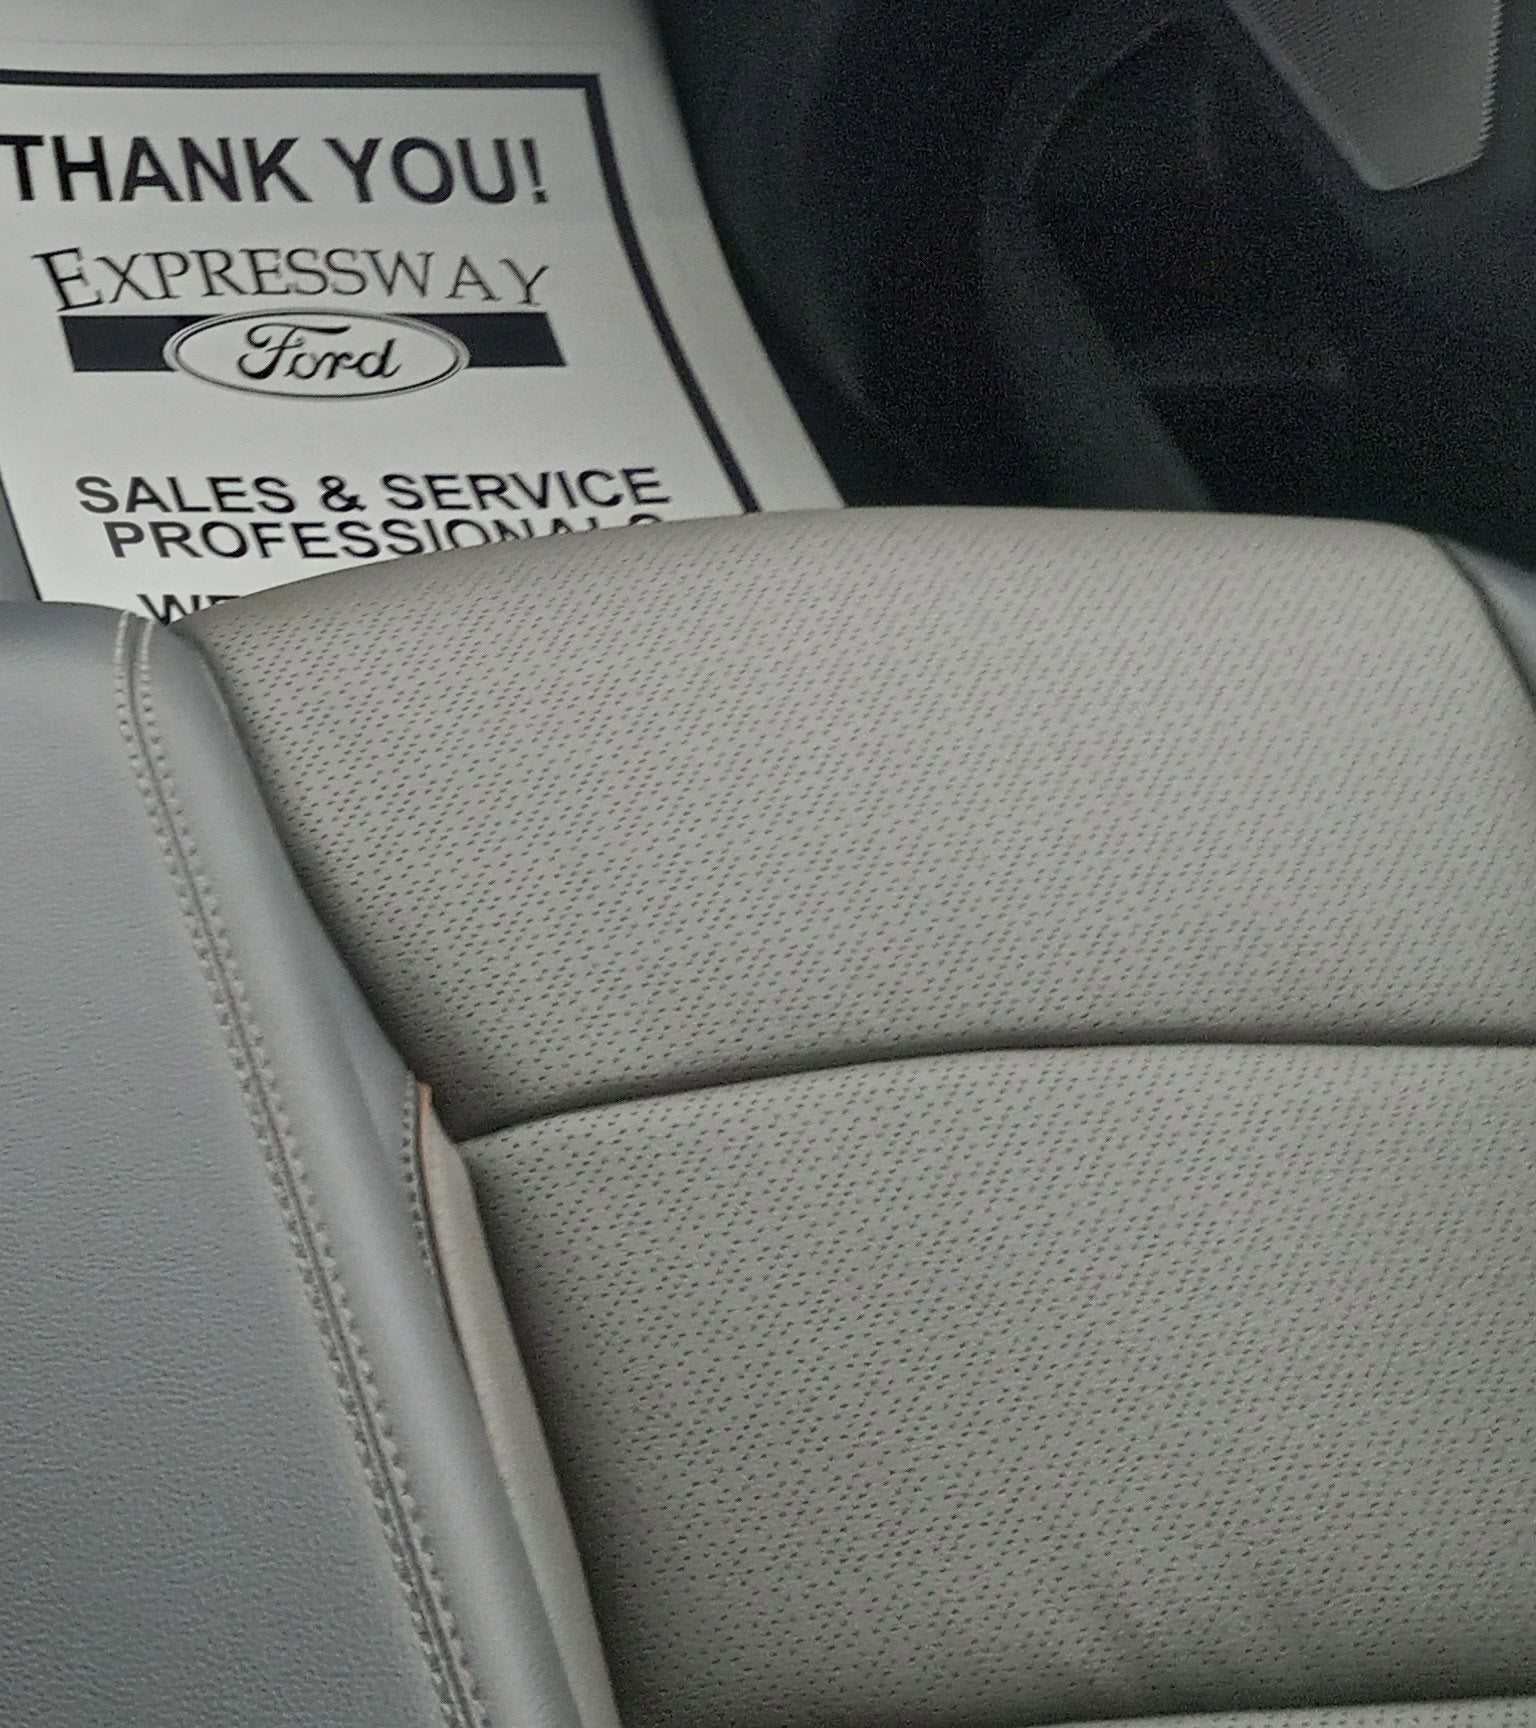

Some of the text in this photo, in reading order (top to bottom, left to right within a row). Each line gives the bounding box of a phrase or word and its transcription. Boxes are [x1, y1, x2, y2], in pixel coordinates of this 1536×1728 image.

[322, 135, 550, 204] YOU!
[33, 248, 550, 313] EXPRESSWAY
[236, 322, 403, 382] Ford
[74, 467, 673, 514] SALES & SERVICE
[102, 513, 663, 560] PROFESSION
